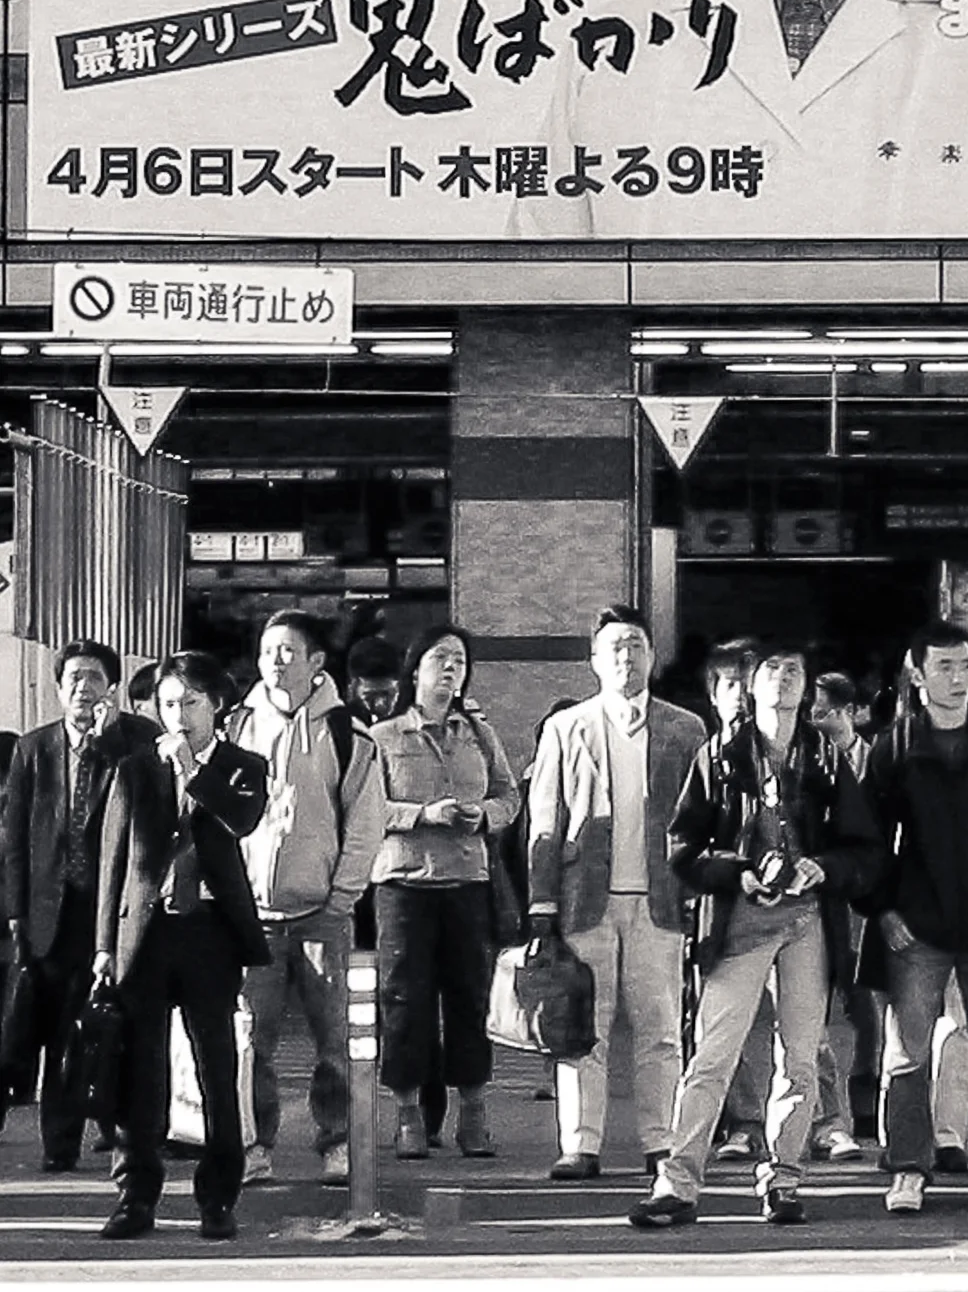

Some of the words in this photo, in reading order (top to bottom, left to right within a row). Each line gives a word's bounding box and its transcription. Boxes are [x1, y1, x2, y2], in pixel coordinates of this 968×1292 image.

[127, 281, 335, 324] 車両通行止め
